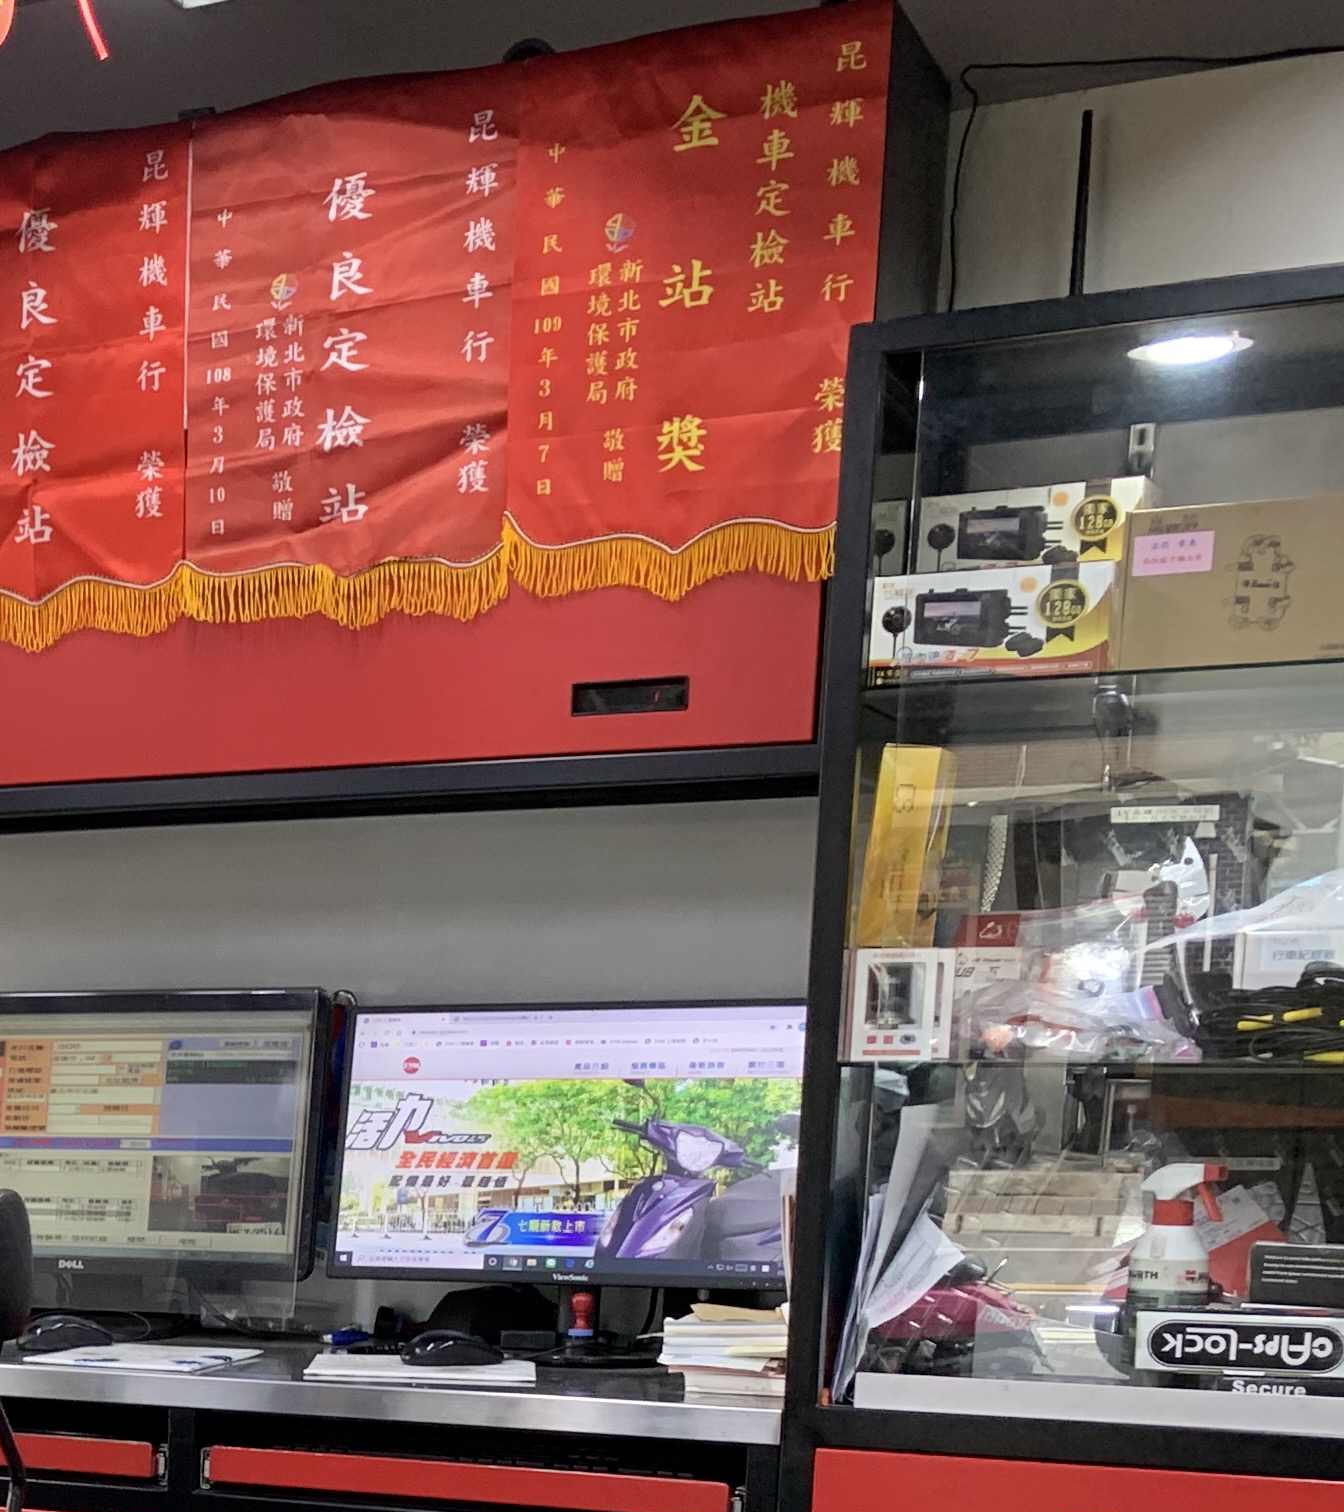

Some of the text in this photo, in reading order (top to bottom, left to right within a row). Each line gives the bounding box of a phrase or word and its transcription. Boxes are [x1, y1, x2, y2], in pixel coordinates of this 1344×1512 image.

[457, 110, 499, 495] 昆輝機車行 榮獲
[657, 93, 727, 474] 金站獎
[747, 79, 799, 315] 機車定檢站
[812, 40, 867, 455] 昆輝機車行 榮獲
[12, 211, 58, 544] 優良定檢站
[136, 150, 169, 519] 昆輝機車行 榮獲
[255, 318, 278, 452] 環境保護局
[282, 314, 305, 447] 新北市政府
[316, 170, 376, 526] 優良定檢站
[586, 263, 612, 406] 環境保護局
[615, 259, 644, 402] 新北市政府
[58, 1259, 84, 1269] DELL
[552, 1273, 589, 1283] ViewSonic
